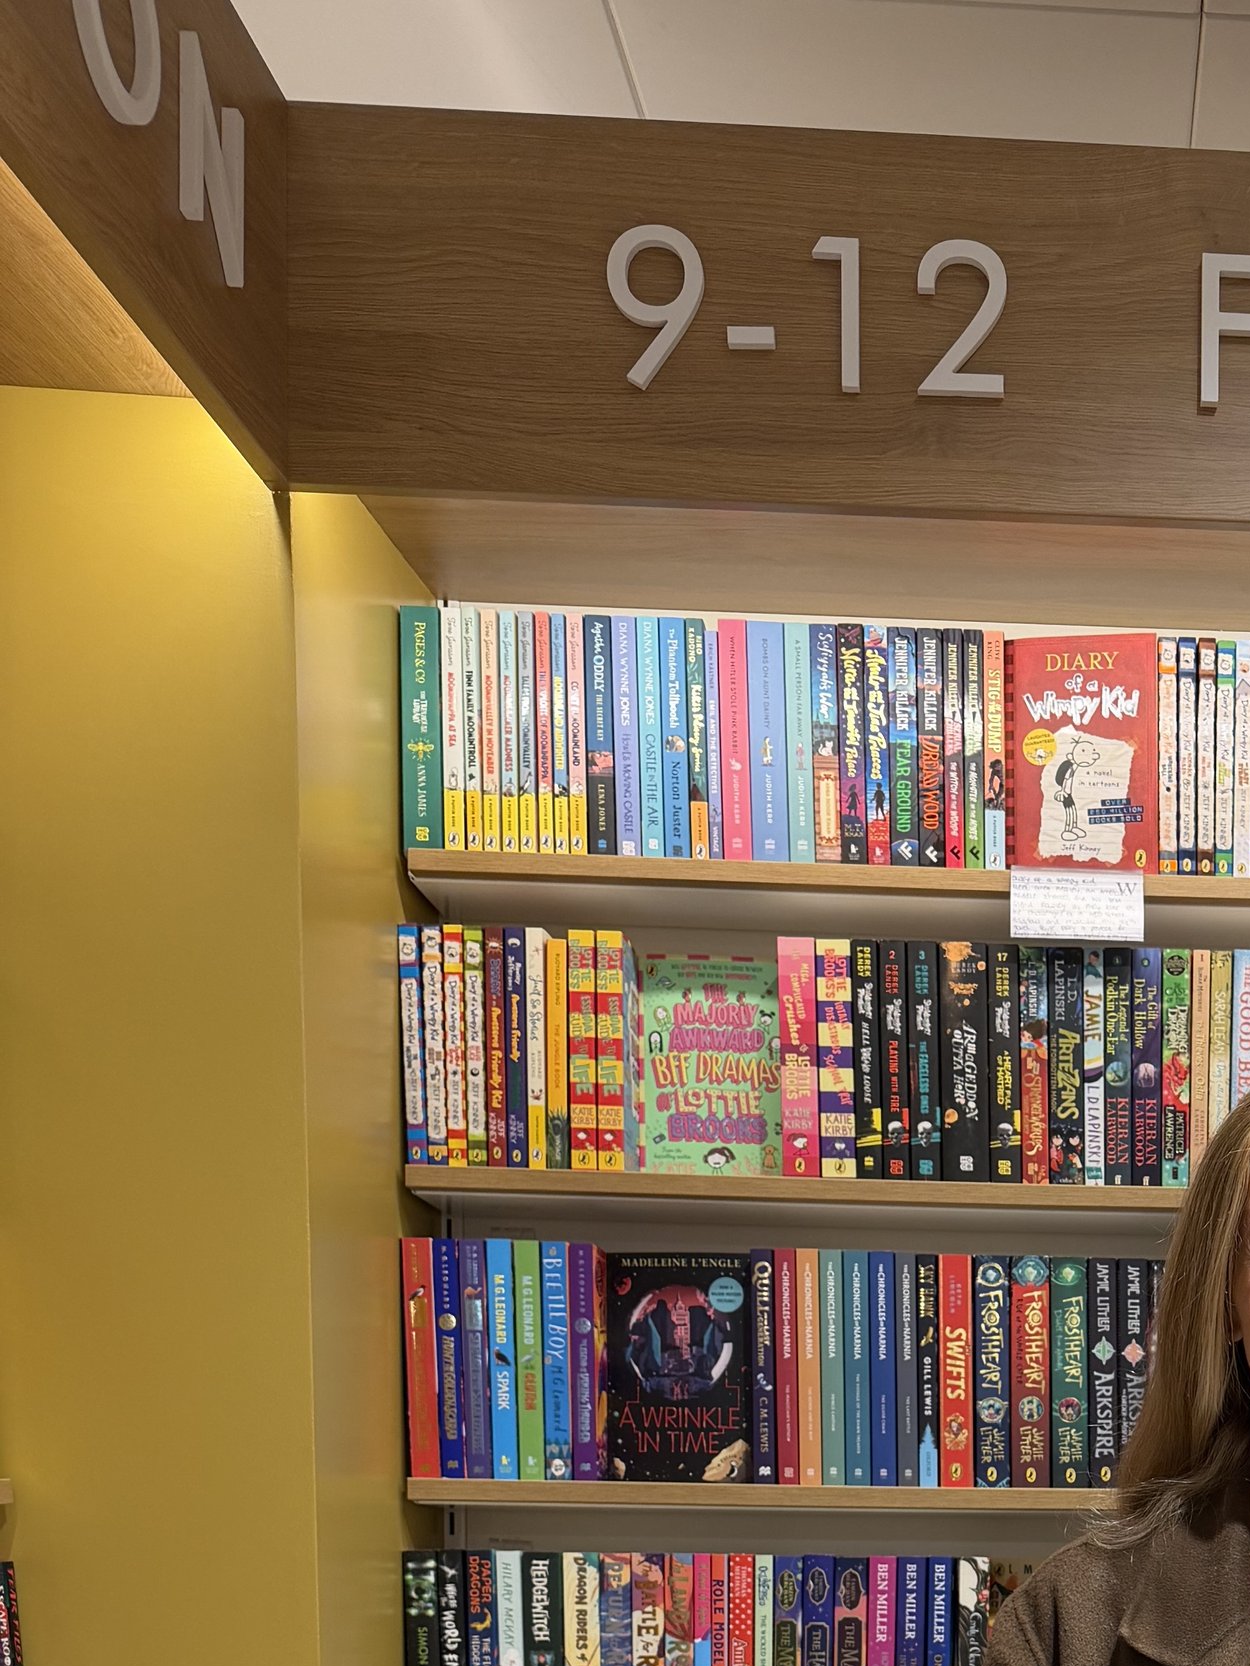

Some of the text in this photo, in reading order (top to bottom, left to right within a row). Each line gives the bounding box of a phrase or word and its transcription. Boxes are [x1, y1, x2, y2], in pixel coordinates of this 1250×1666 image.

[606, 224, 1007, 398] 9-12
[414, 622, 427, 658] PAGES
[1045, 651, 1119, 672] DIARY
[1022, 685, 1140, 726] Wimpy Kid
[1065, 674, 1098, 693] of a
[416, 764, 427, 817] ANNA JAMES
[1088, 780, 1120, 788] cartoons
[1061, 843, 1100, 854] Jeff Kinney
[1117, 882, 1136, 896] W
[1106, 1097, 1117, 1165] LARWOOD
[1117, 1097, 1128, 1165] KIERAN
[621, 1258, 741, 1268] MADELEINE L'ENGLE
[945, 1326, 966, 1401] SWIFTS
[979, 1290, 1004, 1395] FROSTHEART
[619, 1406, 740, 1429] A WRINKLE
[1094, 1370, 1115, 1459] ARKSPIRE
[637, 1431, 719, 1453] IN TIME
[531, 1559, 551, 1644] HEDGEWITCH
[712, 1579, 725, 1665] ROLE MODEL
[873, 1563, 890, 1643] BEN MILLER
